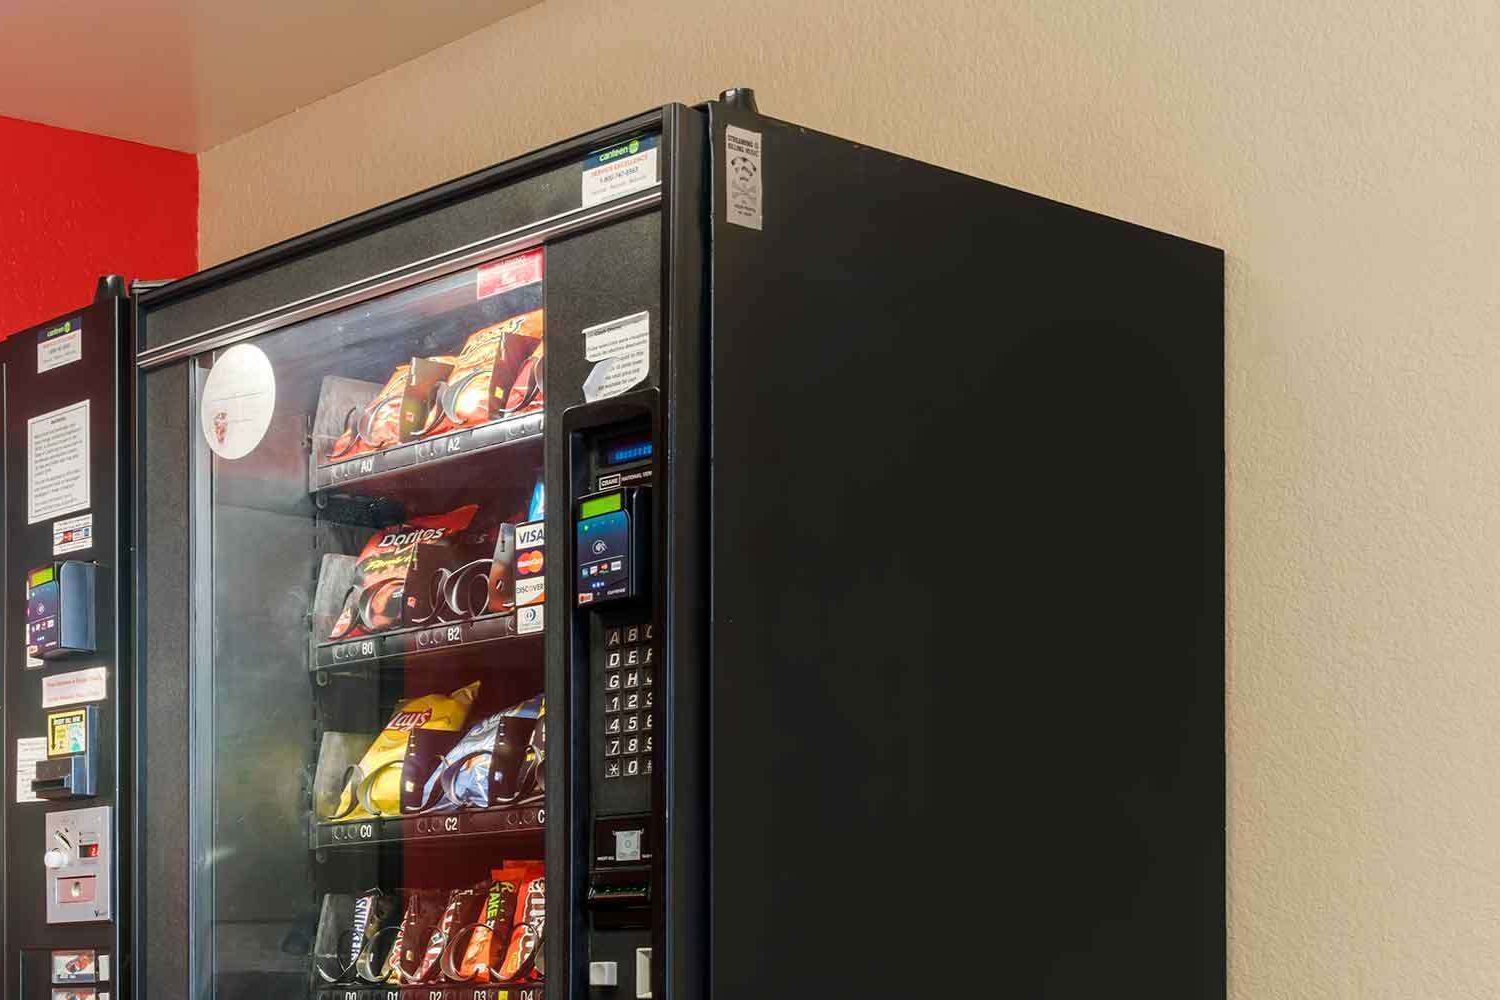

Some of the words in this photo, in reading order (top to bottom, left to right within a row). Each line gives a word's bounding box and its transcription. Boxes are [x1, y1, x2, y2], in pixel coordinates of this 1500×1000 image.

[600, 146, 628, 161] canteen
[448, 438, 460, 451] A2
[378, 527, 446, 547] Doritos
[519, 529, 545, 544] VISA
[609, 631, 619, 646] A
[628, 628, 637, 641] B
[609, 653, 620, 666] D
[628, 650, 637, 664] E
[609, 675, 619, 688] G
[627, 673, 638, 686] H
[611, 697, 619, 711] 1
[628, 694, 638, 708] 2
[387, 711, 431, 732] Lay's
[610, 718, 619, 731] 4
[628, 716, 638, 730] 5
[611, 741, 619, 754] 7
[628, 738, 638, 751] 8
[445, 818, 458, 832] C2
[486, 883, 500, 920] TAKE
